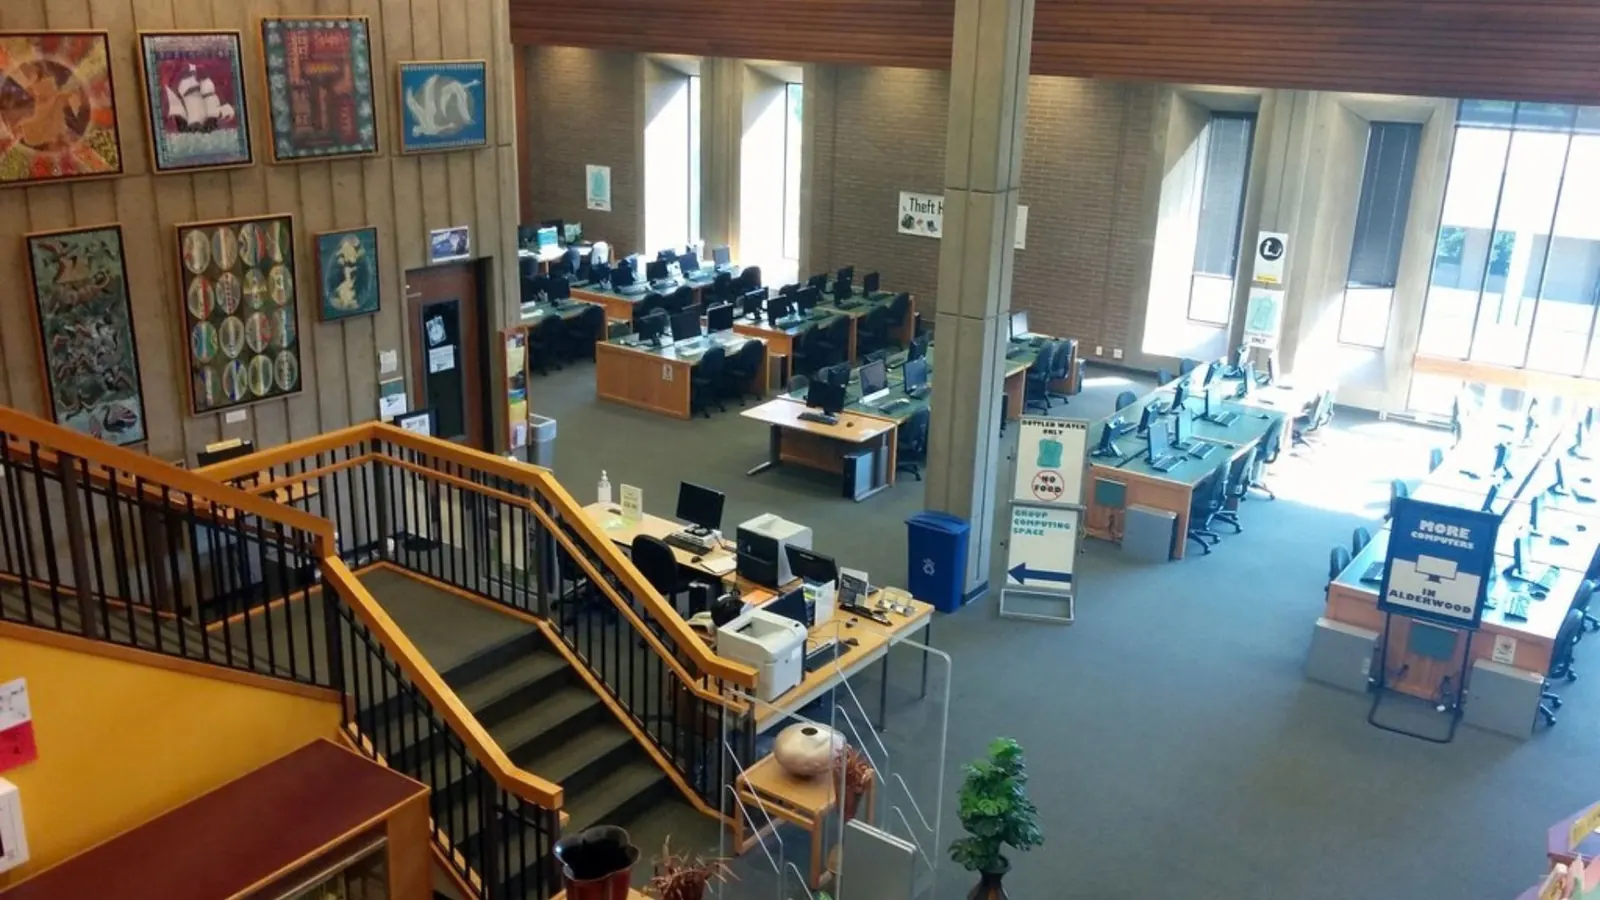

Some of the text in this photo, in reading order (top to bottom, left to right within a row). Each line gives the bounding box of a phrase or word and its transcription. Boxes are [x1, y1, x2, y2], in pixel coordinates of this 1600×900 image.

[909, 197, 936, 215] Theft
[1058, 422, 1086, 430] WATER
[1041, 475, 1056, 483] NO
[1034, 484, 1062, 493] FOOD
[1014, 509, 1049, 519] GROUP
[1014, 518, 1071, 530] COMPUTING
[1419, 519, 1471, 540] MORE
[1013, 527, 1045, 537] SPACE
[1410, 530, 1475, 550] COMPUTERS
[1422, 587, 1437, 598] IN
[1389, 589, 1472, 614] ALDERWOOD
